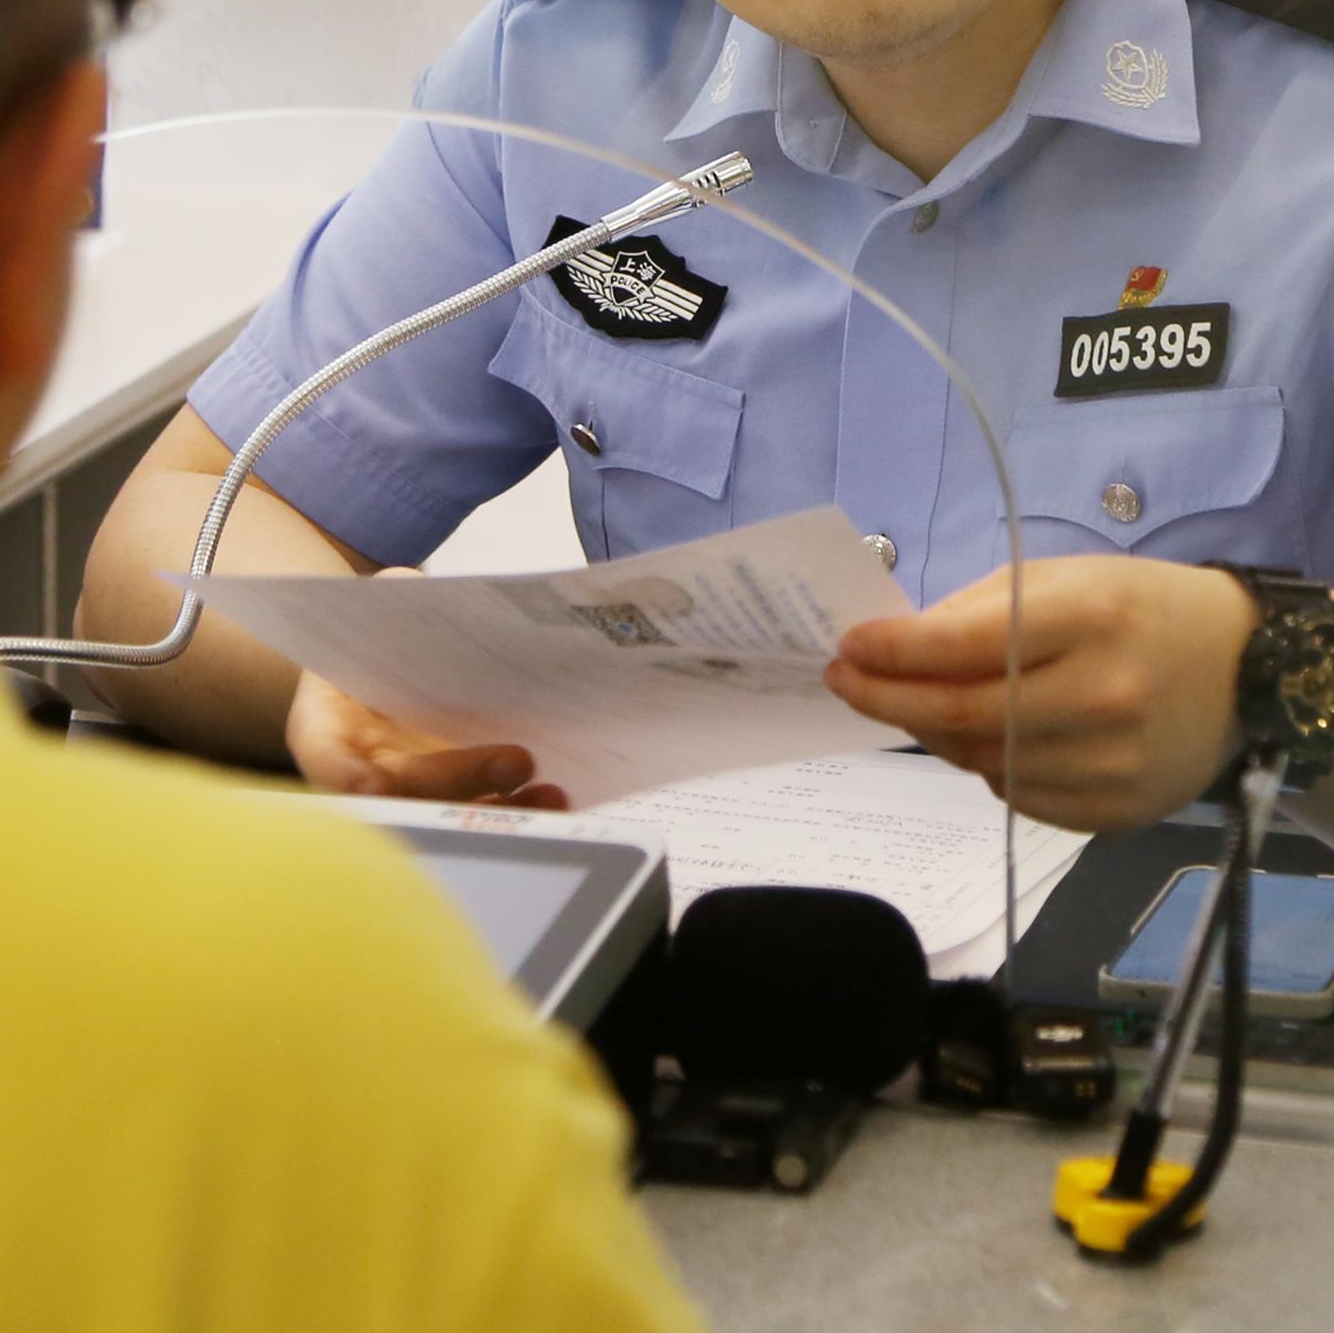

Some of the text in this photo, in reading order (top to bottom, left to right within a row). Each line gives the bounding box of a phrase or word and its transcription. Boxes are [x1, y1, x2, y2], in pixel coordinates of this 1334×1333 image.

[620, 258, 657, 282] 上海
[610, 276, 646, 294] POLICE
[1070, 322, 1212, 377] 005395
